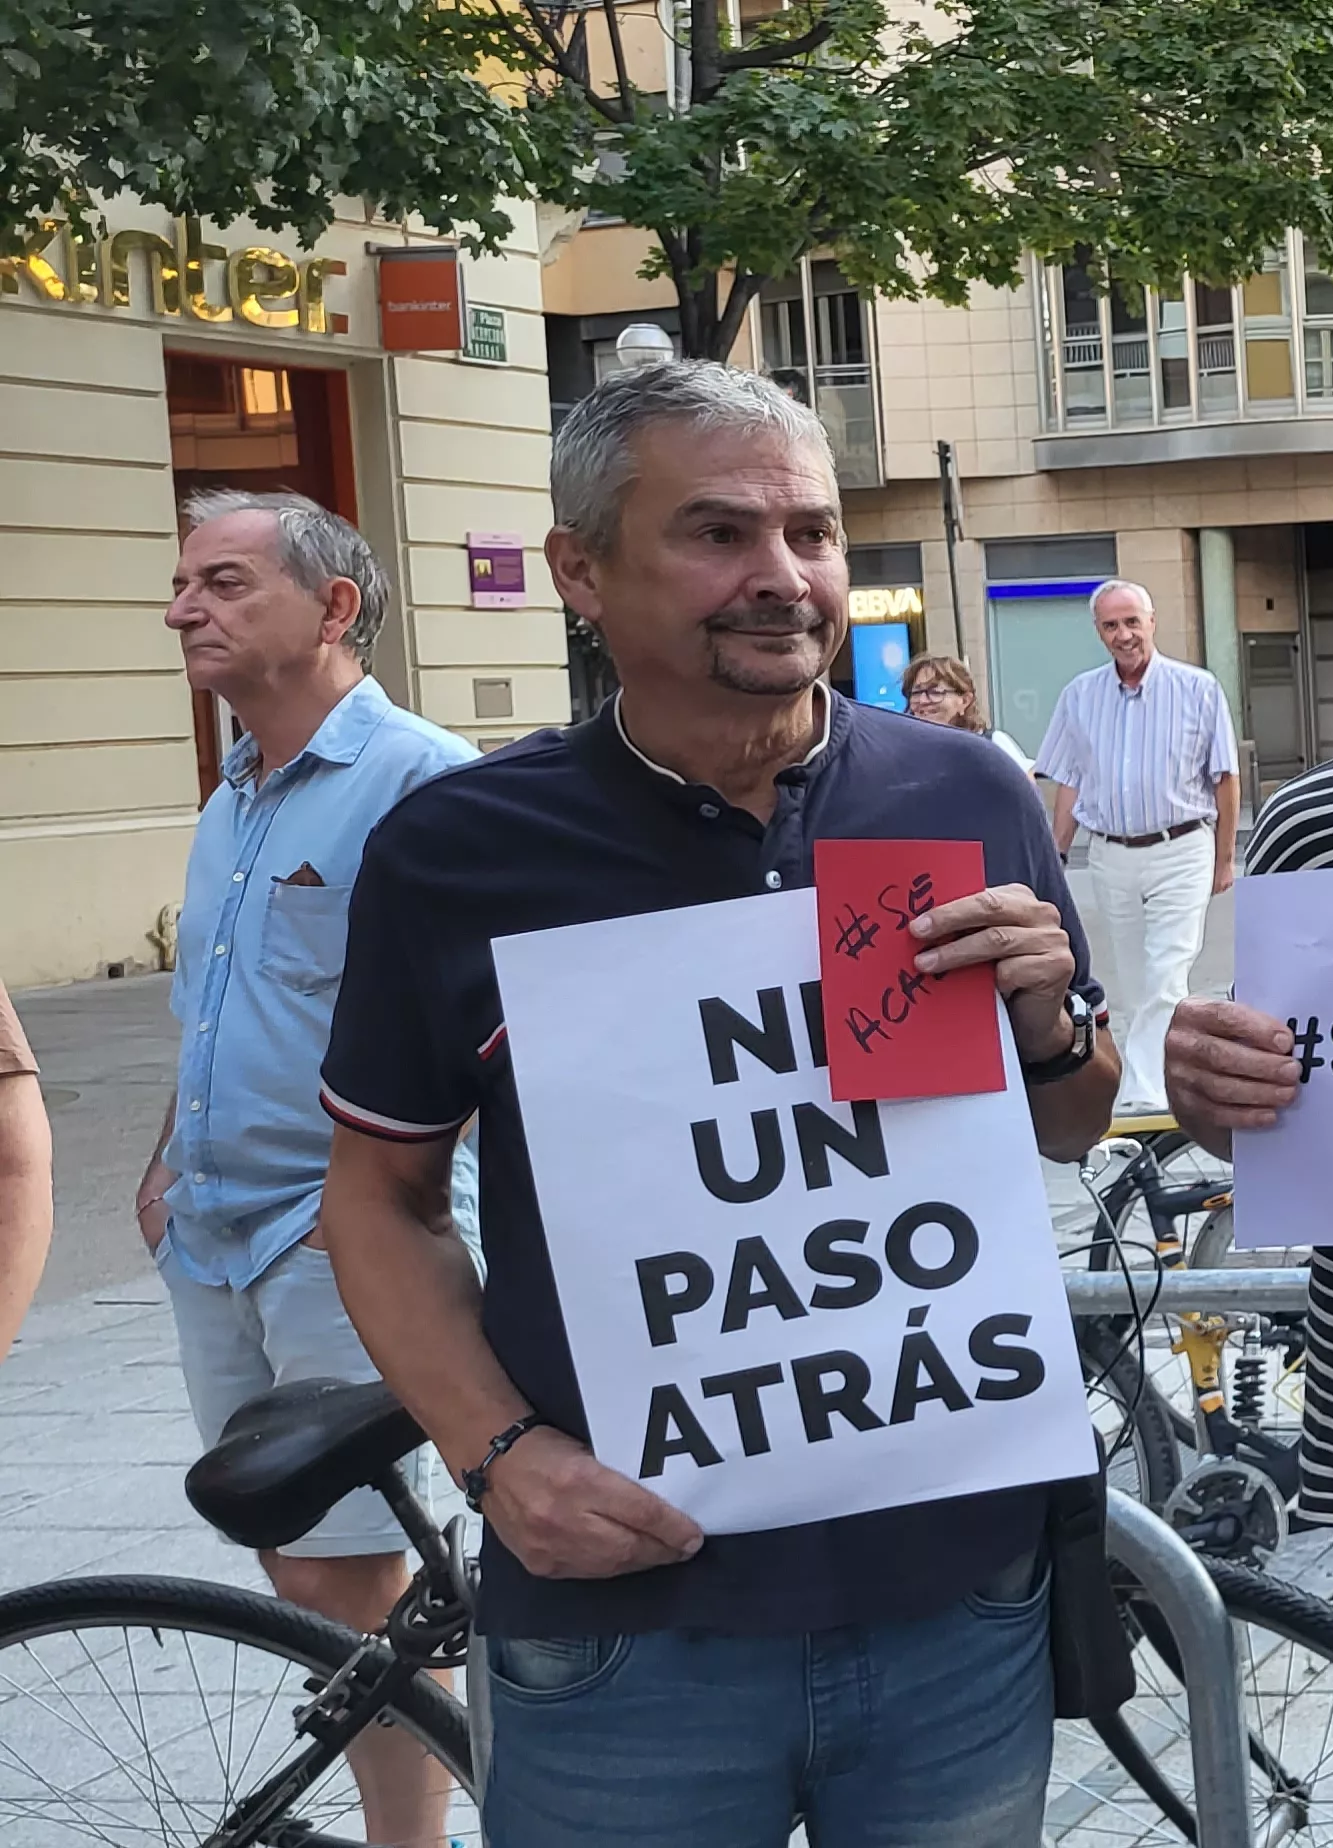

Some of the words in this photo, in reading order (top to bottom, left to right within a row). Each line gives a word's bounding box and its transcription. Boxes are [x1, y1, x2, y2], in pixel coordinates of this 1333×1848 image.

[848, 586, 923, 619] BBVA
[834, 872, 936, 960] #SE
[697, 979, 831, 1085] NI
[845, 968, 949, 1055] ACA
[690, 1099, 891, 1205] UN
[634, 1200, 980, 1348] PASO
[638, 1304, 1046, 1480] ATRÁS
